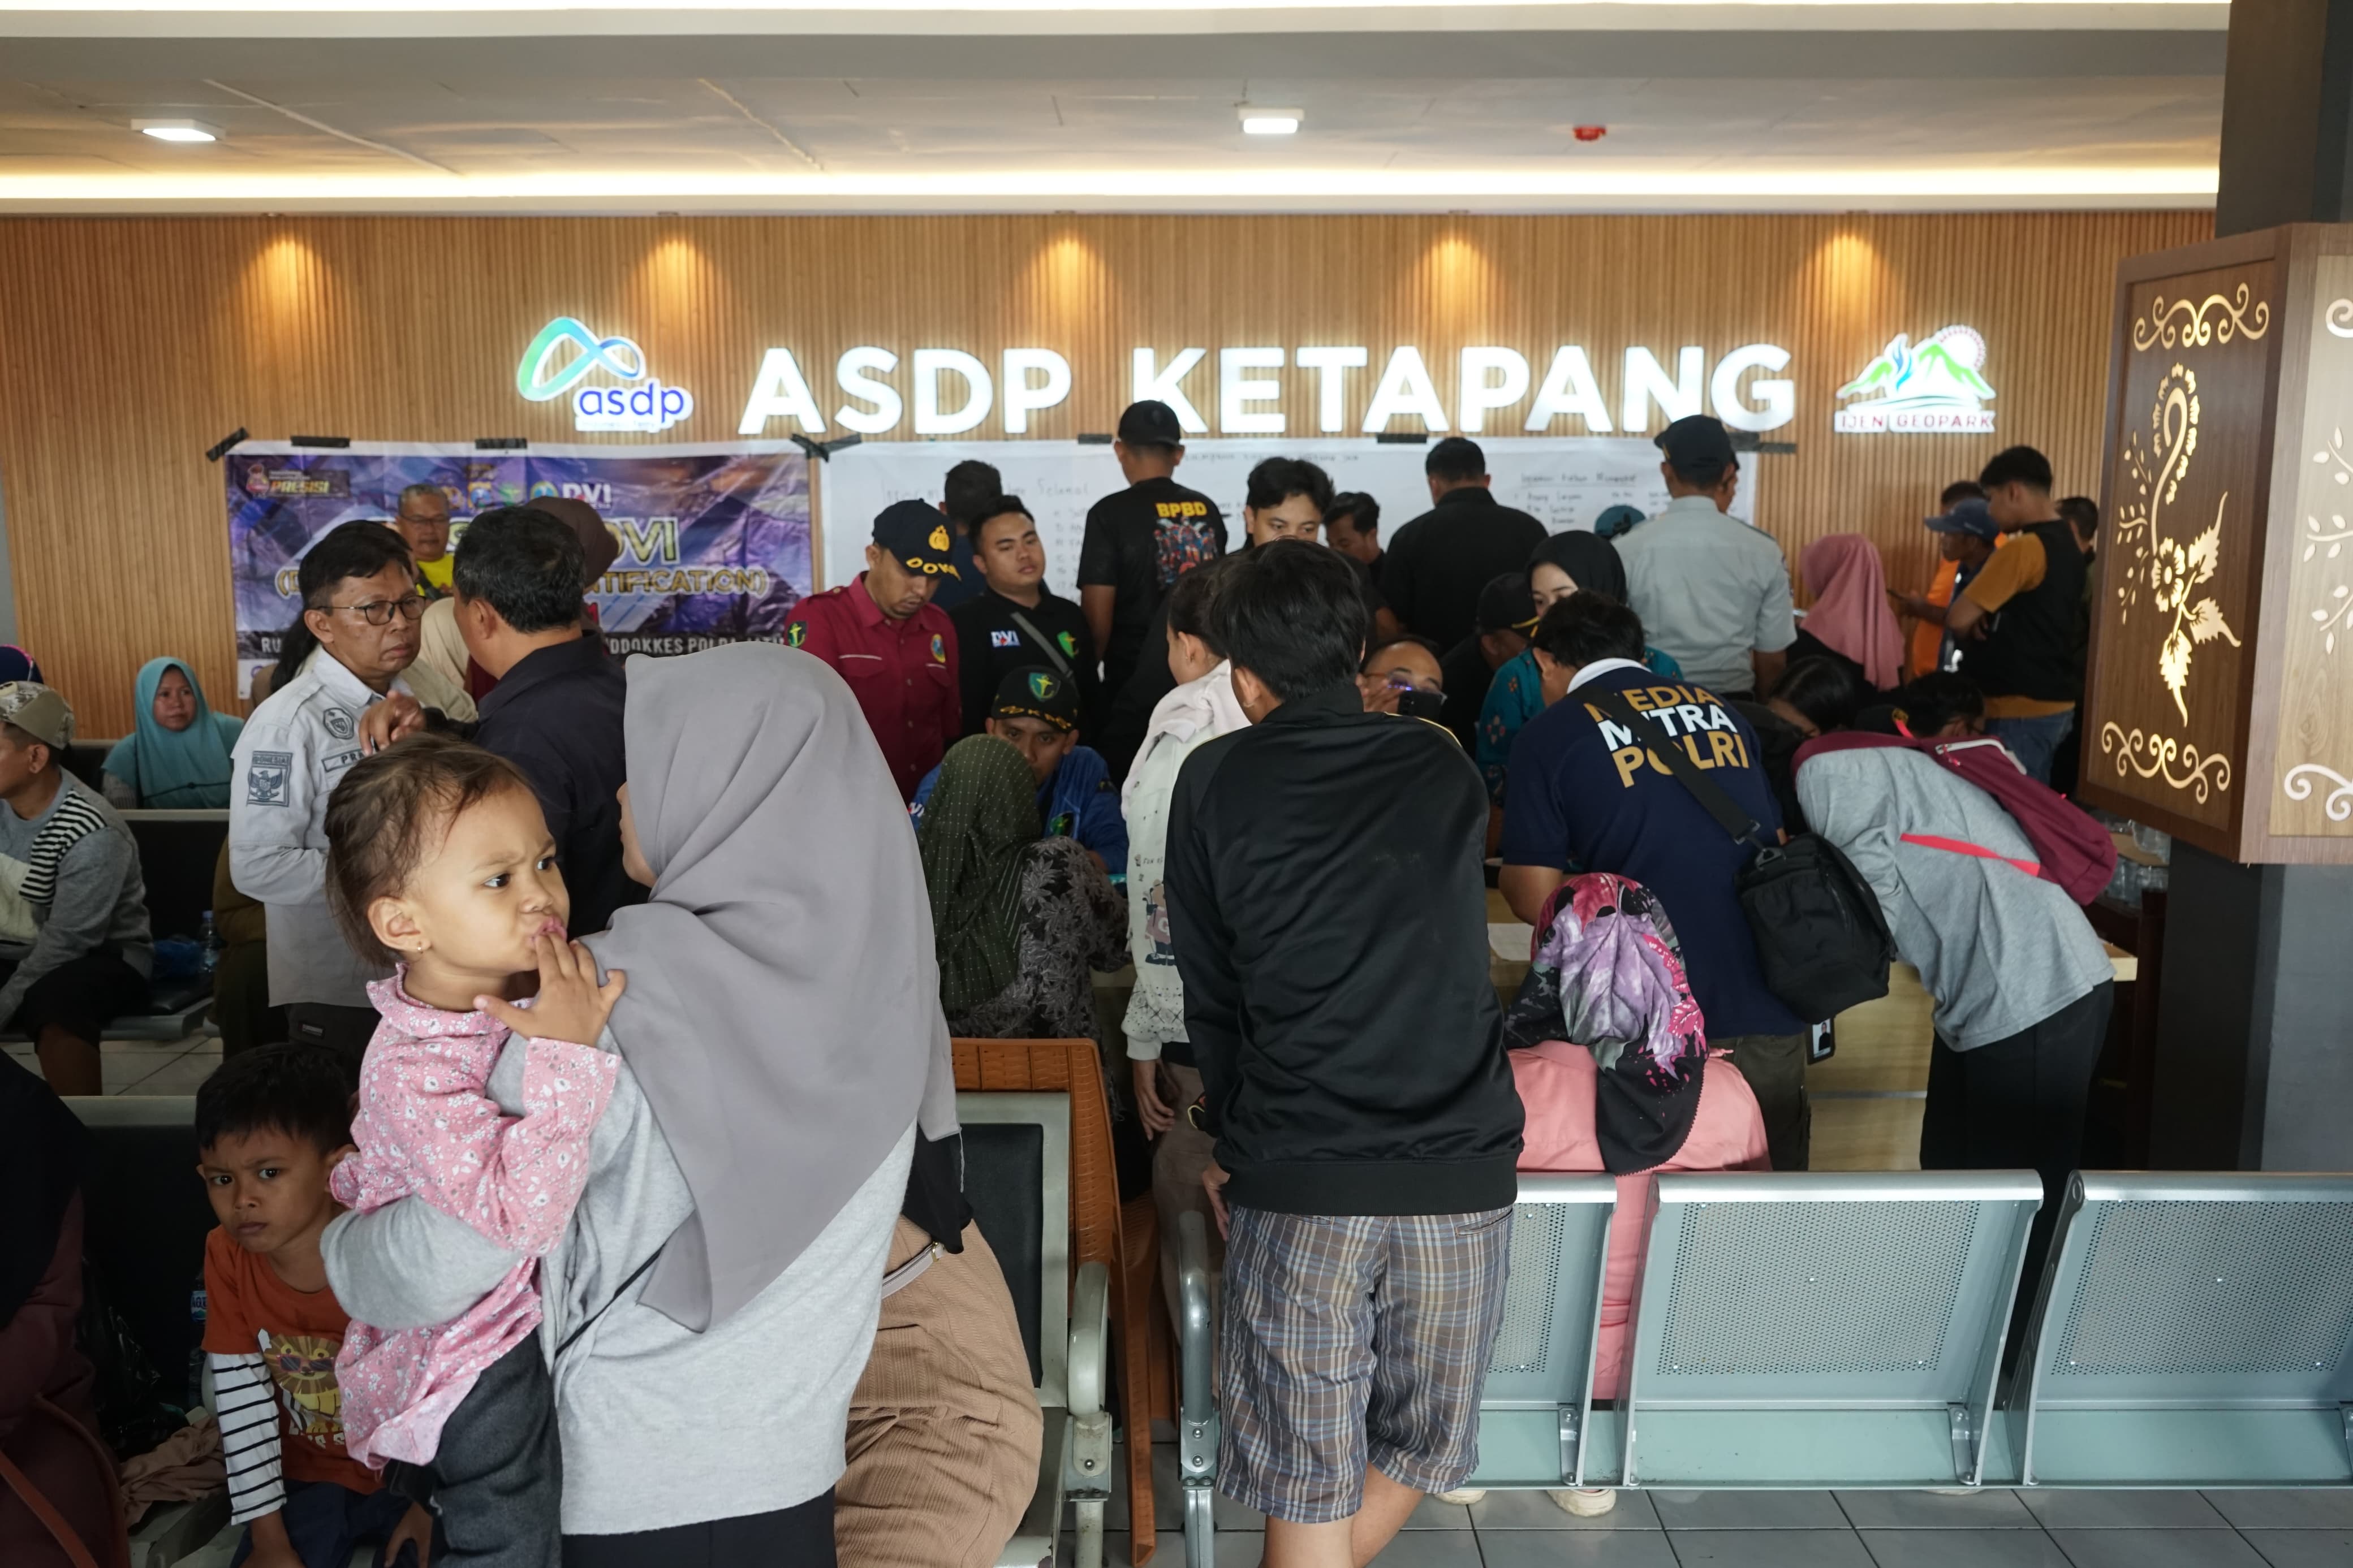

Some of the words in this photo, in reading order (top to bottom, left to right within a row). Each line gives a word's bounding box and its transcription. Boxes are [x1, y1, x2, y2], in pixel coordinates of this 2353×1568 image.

[738, 346, 1072, 434] ASDP
[1132, 344, 1795, 433] KETAPANG
[579, 382, 685, 424] asdp
[1842, 414, 1884, 428] IJEN
[1897, 413, 1992, 428] GEOPARK
[562, 482, 611, 504] DVI
[1155, 501, 1208, 517] BPBD
[990, 630, 1020, 643] DVI
[1597, 703, 1738, 751] MTRA
